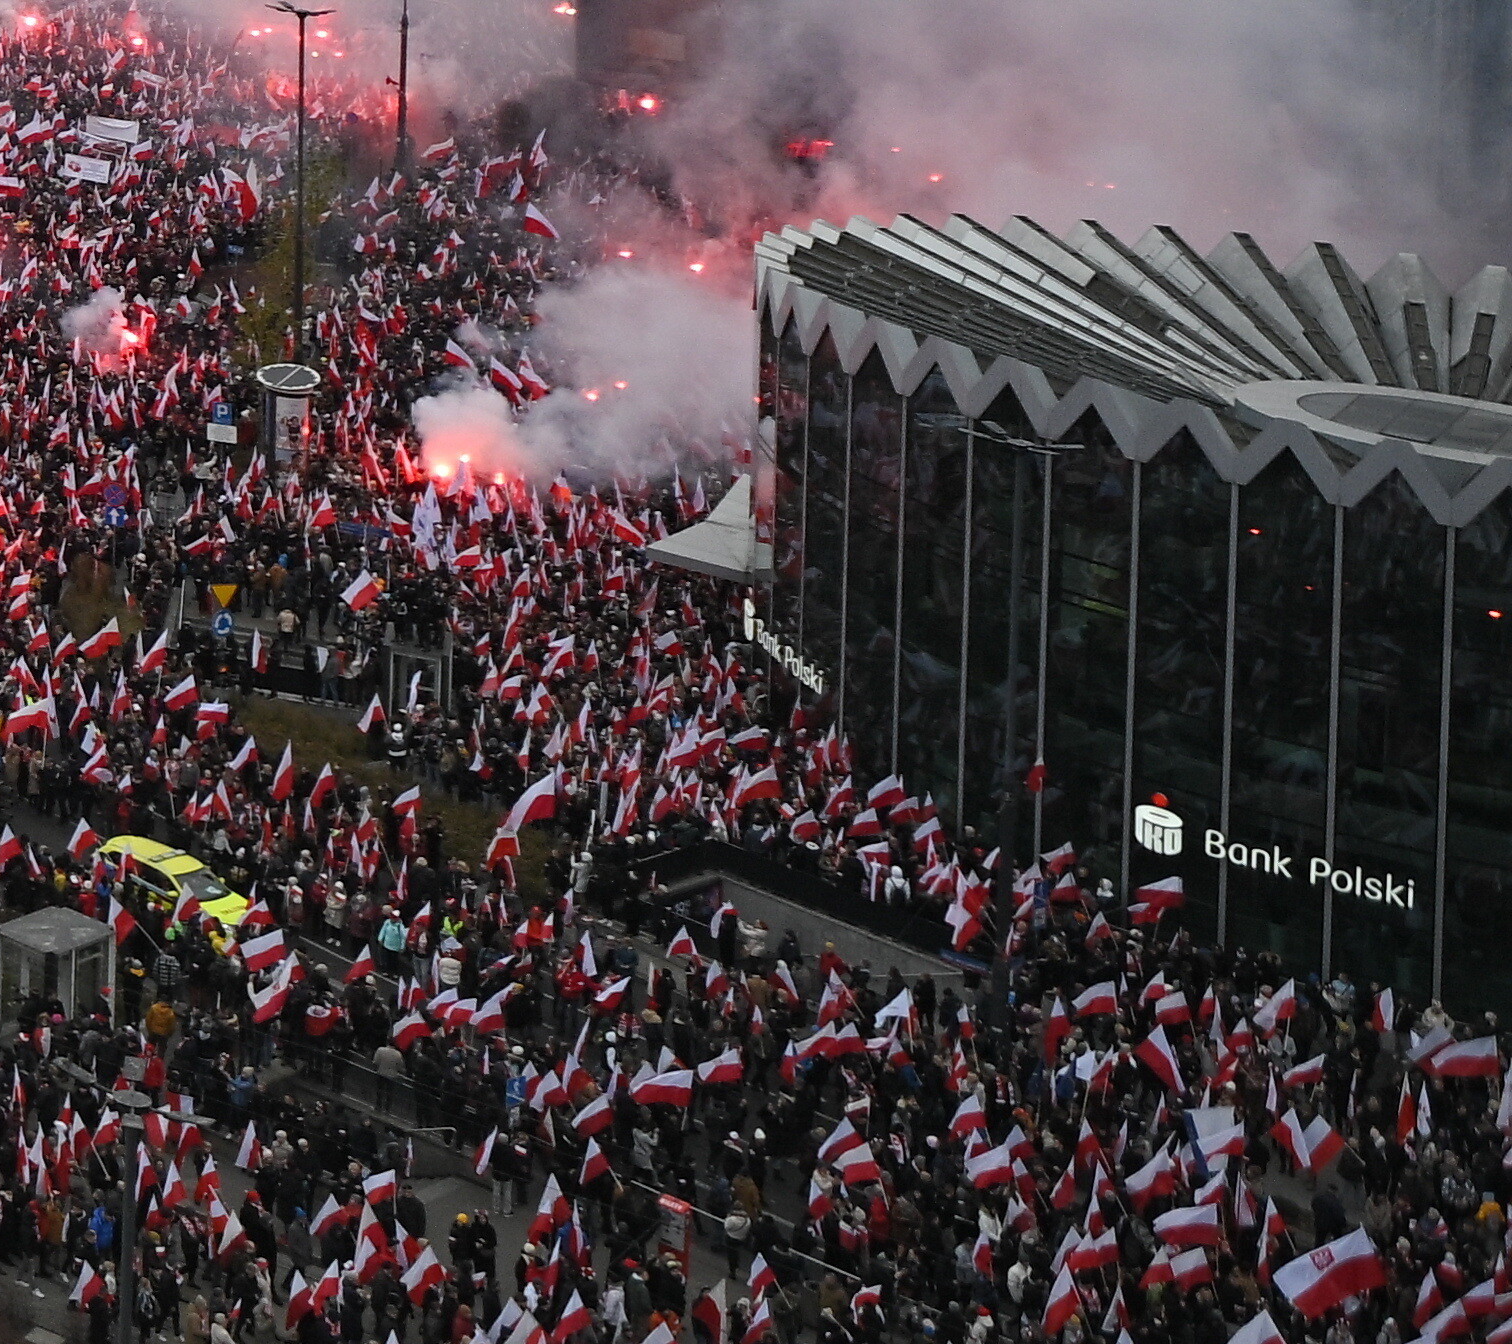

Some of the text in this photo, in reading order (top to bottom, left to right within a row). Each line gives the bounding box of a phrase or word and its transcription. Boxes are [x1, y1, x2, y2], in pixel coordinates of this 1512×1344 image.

[755, 618, 824, 695] Bank Polski
[1204, 828, 1417, 911] Bank Polski
